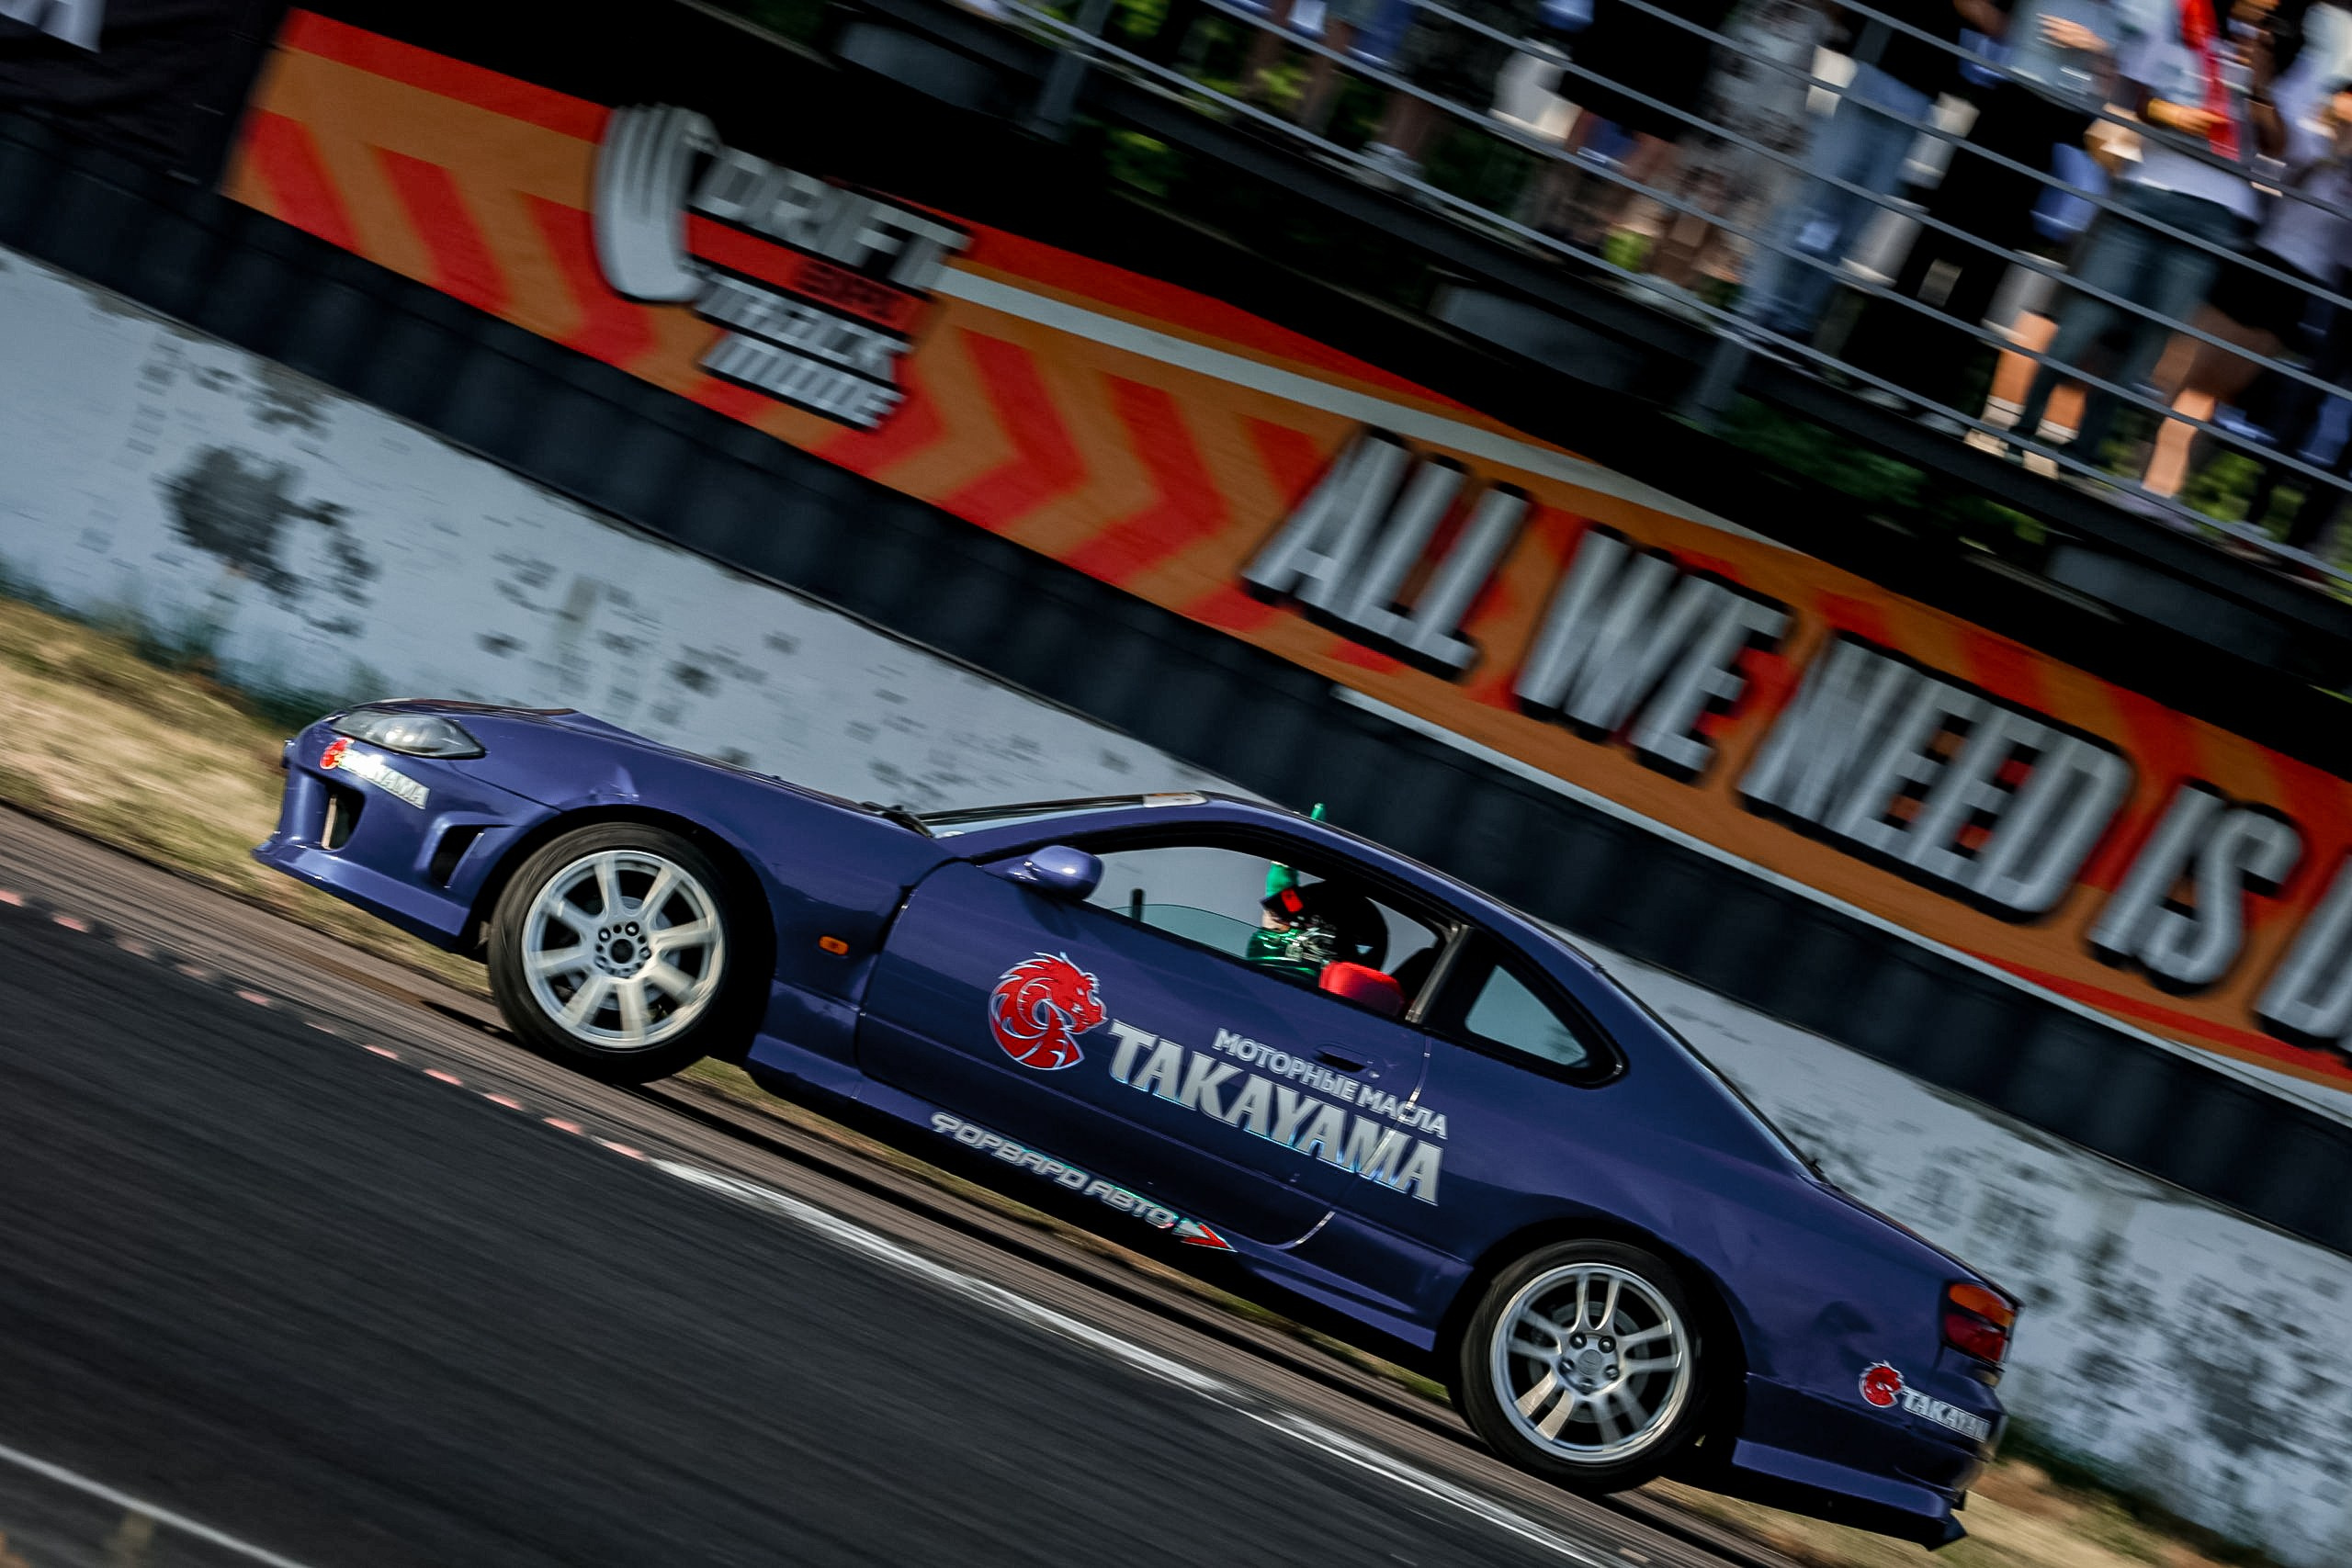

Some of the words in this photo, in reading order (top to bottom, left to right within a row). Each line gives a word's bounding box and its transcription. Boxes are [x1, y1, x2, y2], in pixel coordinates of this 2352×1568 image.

[687, 144, 974, 291] DRIFT
[1240, 432, 1532, 674] ALL
[1511, 525, 1795, 776] WE
[1736, 631, 2136, 916] NEED
[2086, 780, 2302, 986] IS
[1106, 1018, 1445, 1207] TAKAYAMA
[1212, 1027, 1360, 1104] МОТОРНЫЕ
[1358, 1077, 1450, 1140] МАСЛА
[1085, 1179, 1180, 1231] АВТО
